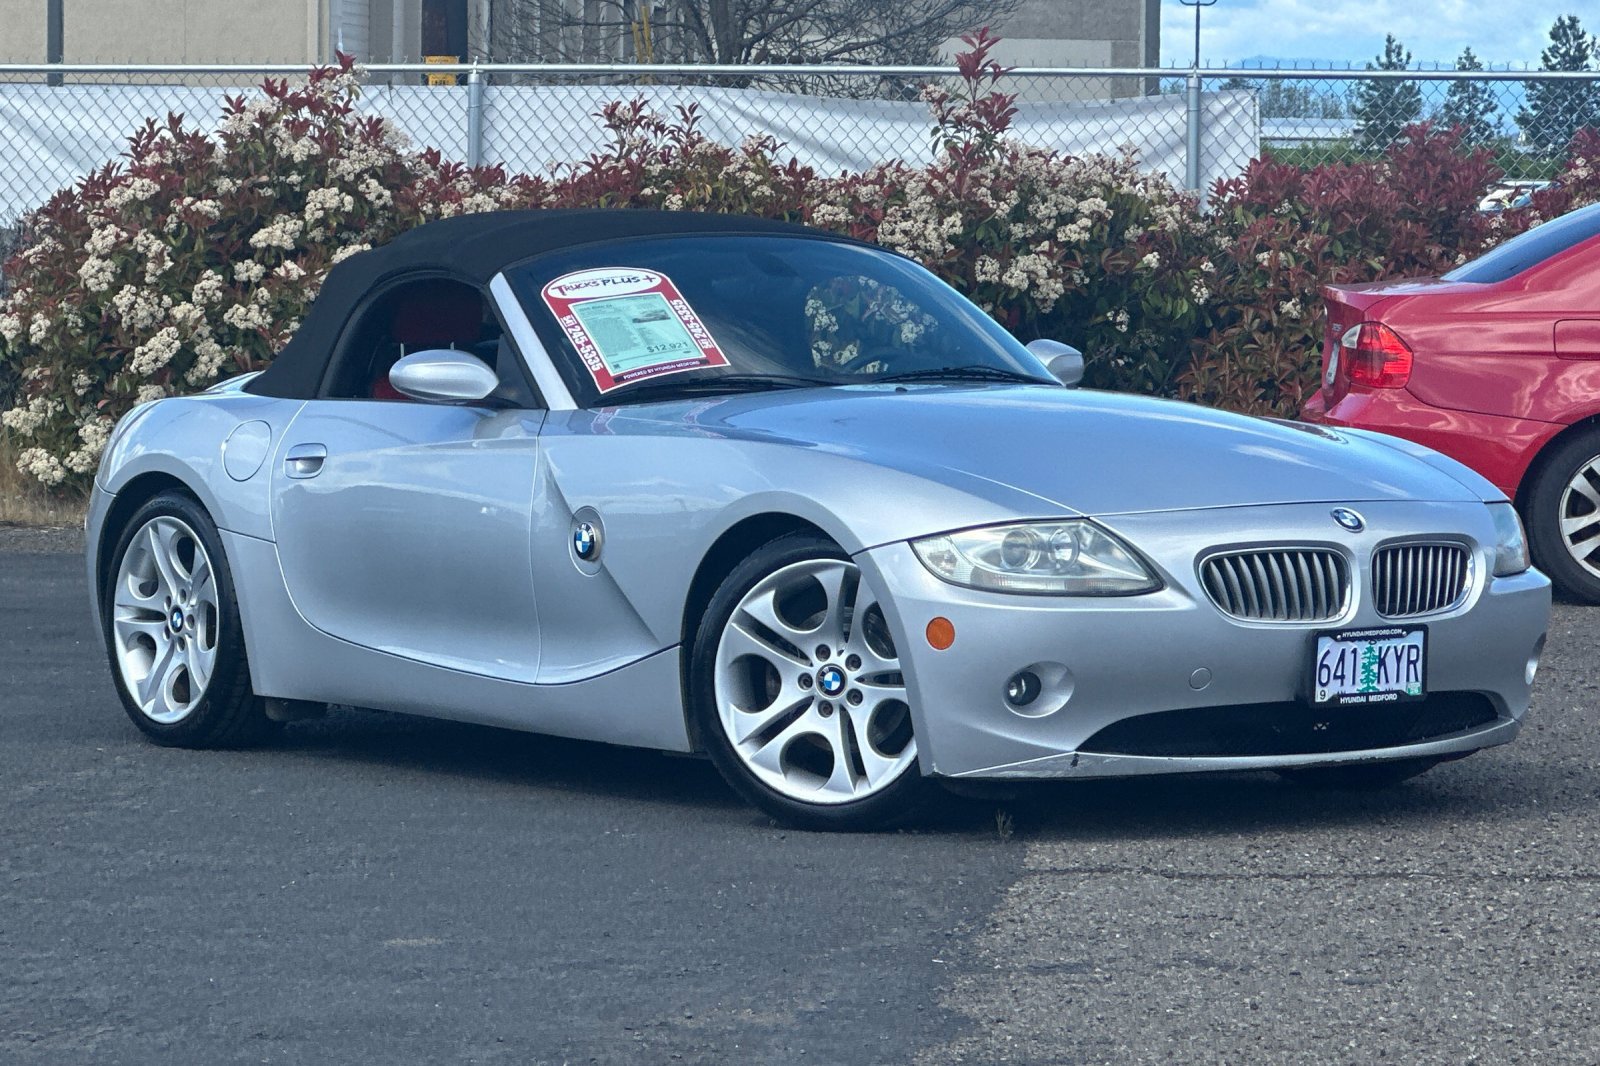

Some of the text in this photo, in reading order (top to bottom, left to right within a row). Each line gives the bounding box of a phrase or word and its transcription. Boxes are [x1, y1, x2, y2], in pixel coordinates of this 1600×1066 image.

[670, 299, 707, 339] 245-5335
[567, 324, 603, 371] 245-5335
[623, 369, 648, 380] POWERED
[1342, 628, 1402, 638] HYUNDAIMEDFORD.COM
[1317, 644, 1420, 687] 641 KYR
[1319, 689, 1327, 700] 9
[1340, 693, 1398, 704] HYUNDAI MEDFORD
